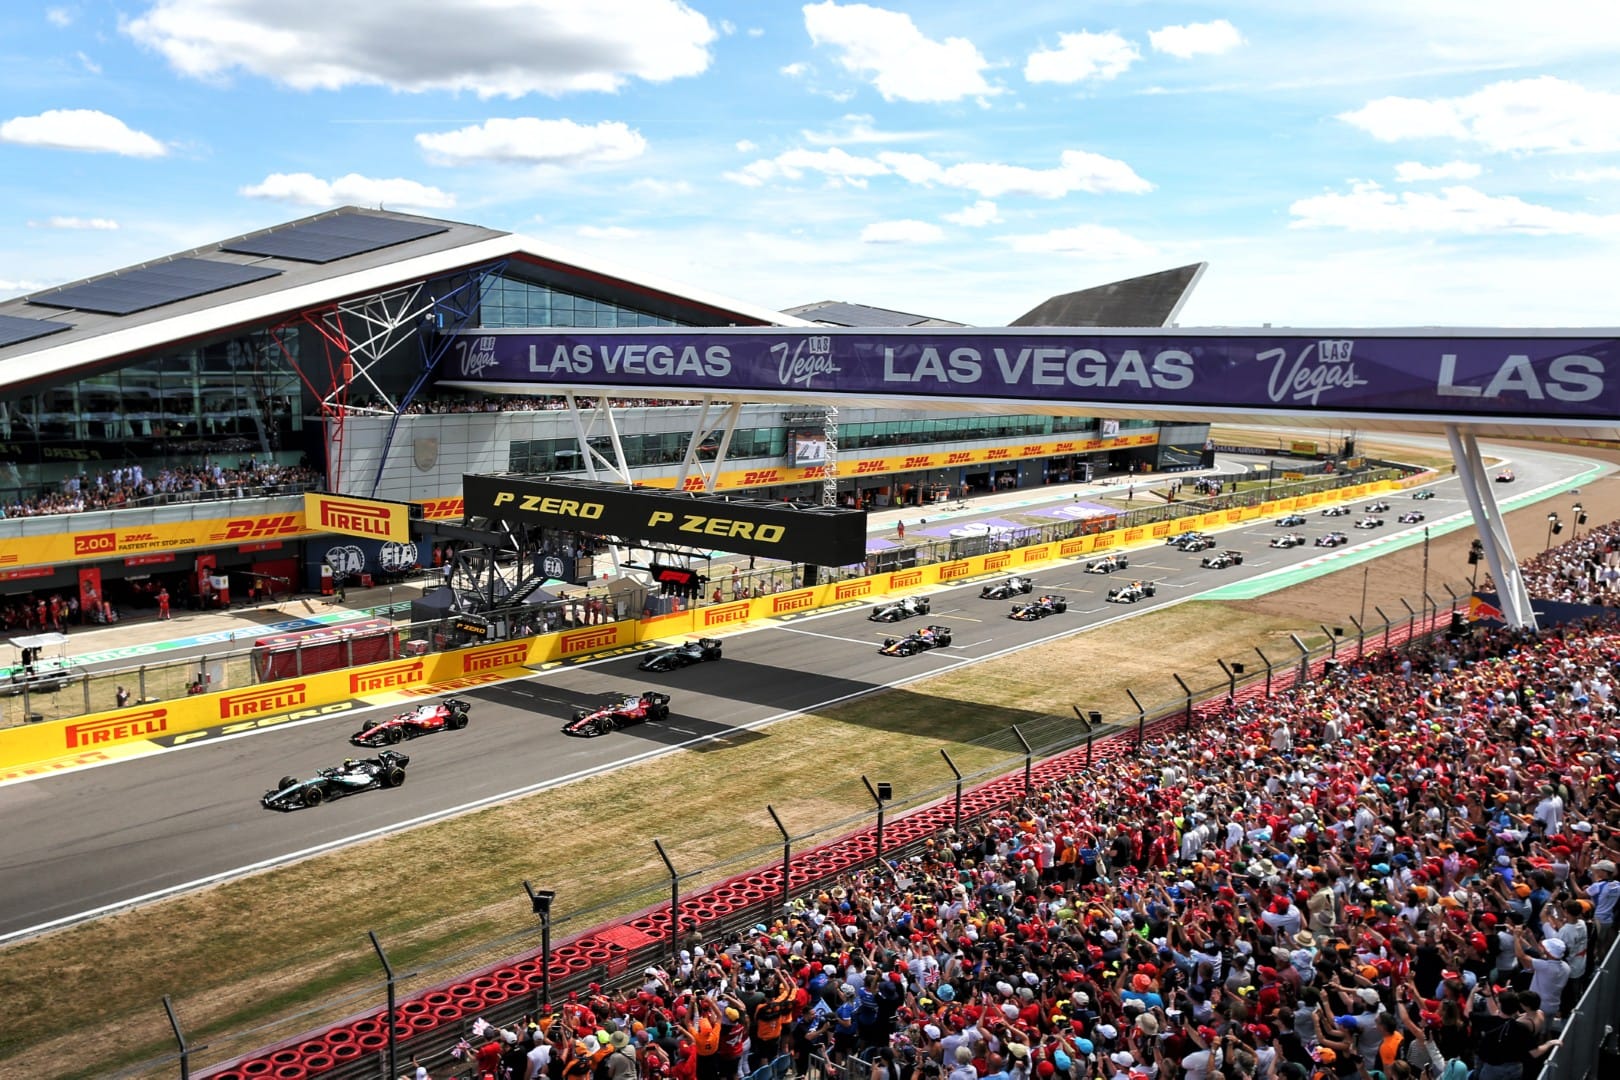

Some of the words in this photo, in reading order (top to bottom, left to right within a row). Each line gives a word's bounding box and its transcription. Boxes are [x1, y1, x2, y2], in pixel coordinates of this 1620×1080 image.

[810, 336, 830, 353] LAS
[1320, 341, 1353, 361] LAS
[455, 338, 499, 379] Vegas
[529, 344, 593, 374] LAS
[600, 345, 732, 377] VEGAS
[770, 339, 841, 388] Vegas
[883, 347, 983, 384] LAS
[993, 348, 1195, 390] VEGAS
[1256, 344, 1368, 406] Vegas
[1437, 353, 1605, 402] LAS
[904, 456, 930, 469] DHL
[948, 452, 971, 464] DHL
[987, 448, 1009, 459] DHL
[743, 471, 778, 485] DHL
[857, 460, 885, 473] DHL
[493, 492, 515, 507] P
[519, 495, 604, 520] ZERO
[225, 515, 300, 540] DHL
[320, 500, 391, 536] PIRELLI
[647, 511, 674, 527] P
[678, 514, 786, 543] ZERO
[118, 542, 149, 551] FASTEST
[124, 533, 153, 542] DHL
[1060, 540, 1083, 555] PIRELLI
[984, 554, 1011, 570] PIRELLI
[1024, 547, 1048, 562] PIRELLI
[890, 571, 922, 589] PIRELLI
[940, 562, 969, 579] PIRELLI
[836, 580, 871, 600] PIRELLI
[773, 591, 813, 613] PIRELLI
[705, 603, 749, 626] PIRELLI
[561, 627, 617, 653] PIRELLI
[464, 643, 528, 673] PIRELLI
[350, 662, 424, 694] PIRELLI
[220, 683, 306, 719] PIRELLI
[65, 709, 168, 749] PIRELLI
[173, 731, 208, 745] P
[222, 702, 353, 735] ZERO
